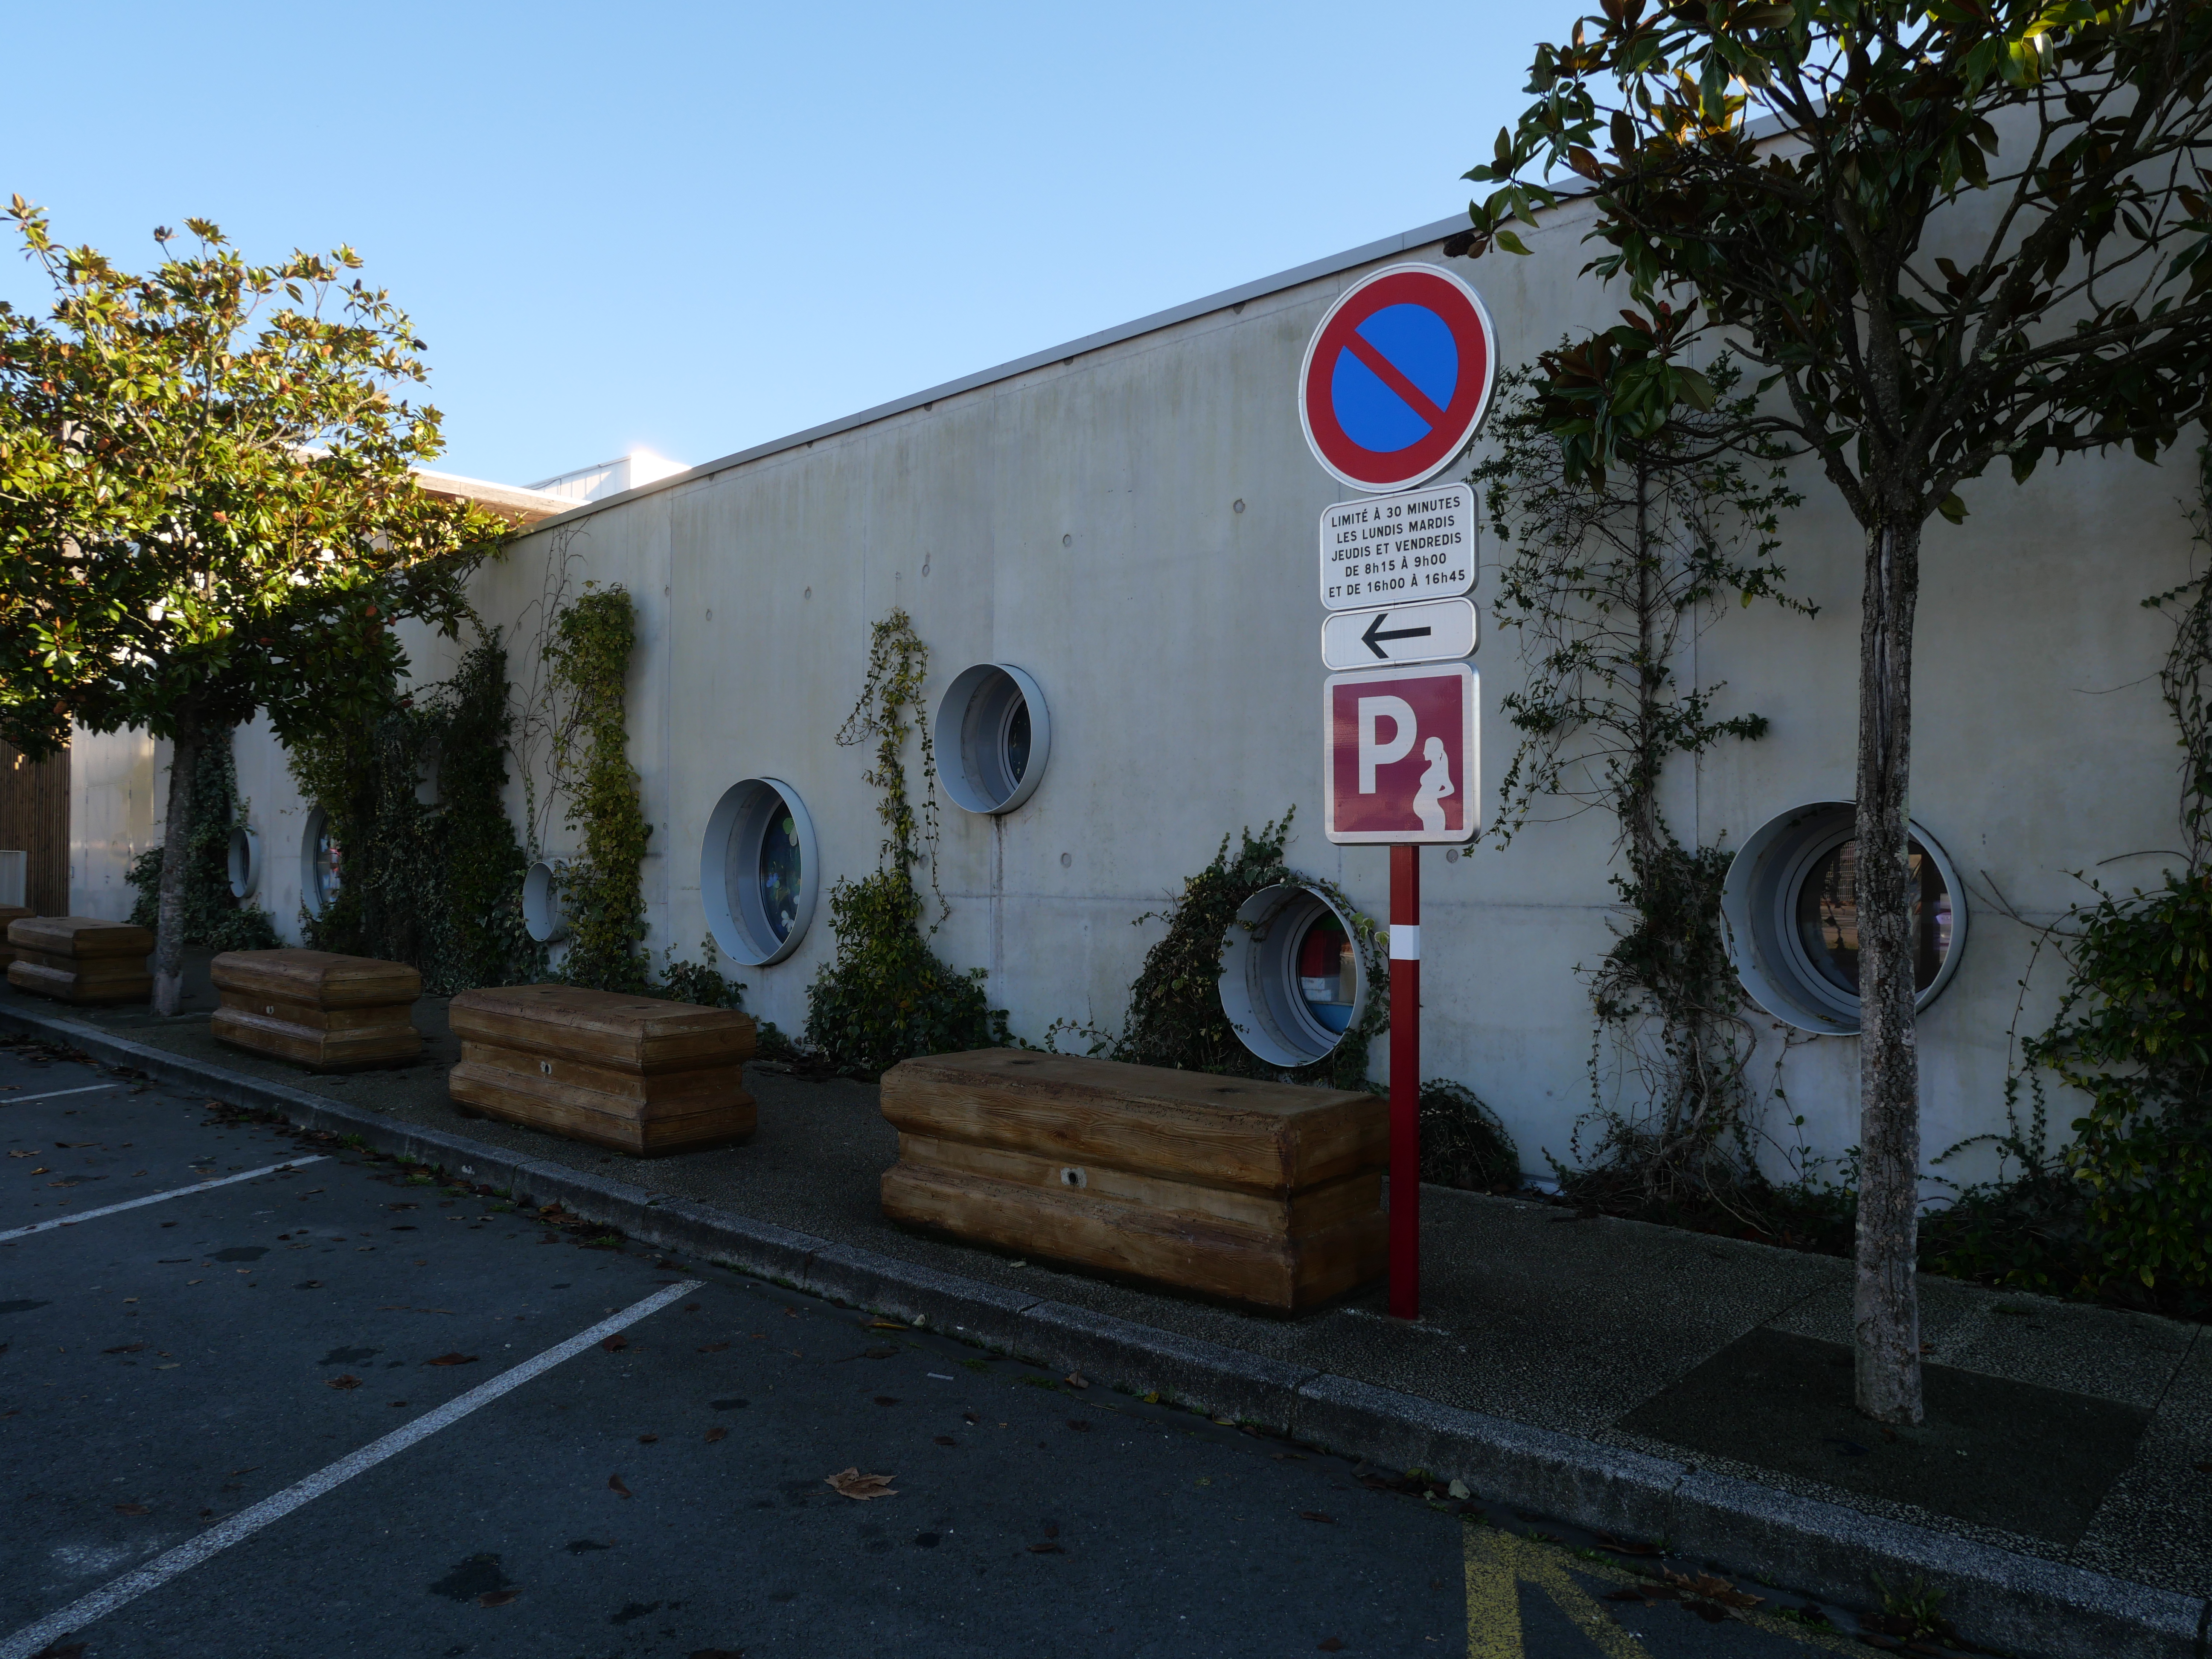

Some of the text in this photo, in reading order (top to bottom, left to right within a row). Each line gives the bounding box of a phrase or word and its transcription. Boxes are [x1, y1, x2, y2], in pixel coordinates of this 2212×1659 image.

[1332, 497, 1460, 527] LIMITÉ À 30 MINUTES
[1337, 515, 1454, 543] LES LUNDIS MARDIS
[1332, 533, 1461, 561] JEUDIS ET VENDREDIS
[1345, 553, 1446, 577] DE 8h15 À 9h00
[1329, 570, 1465, 597] ET DE 16h00 À 16h45
[1358, 696, 1417, 794] P
